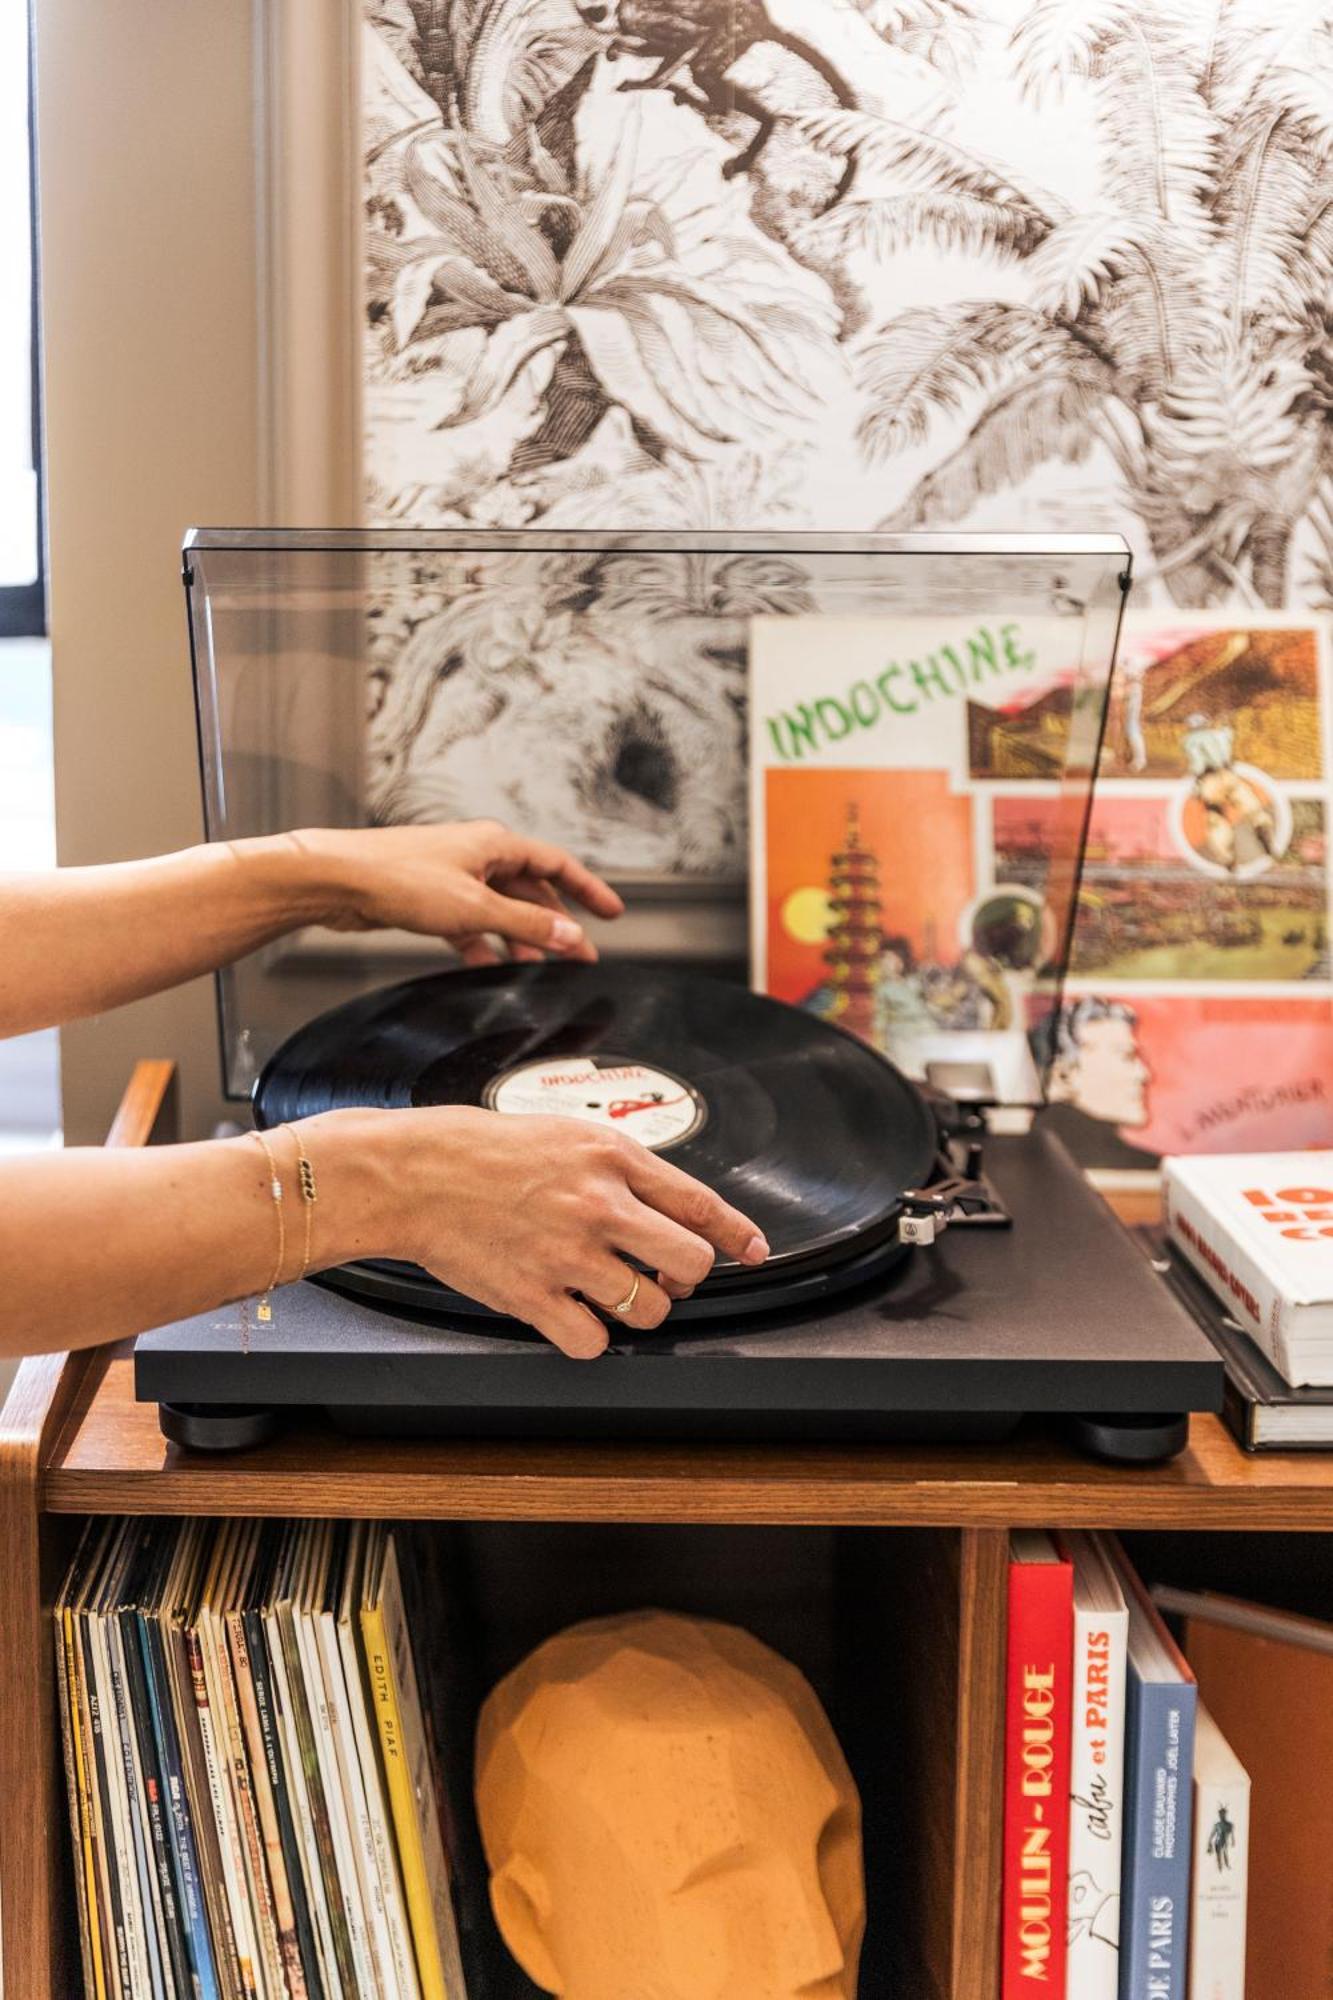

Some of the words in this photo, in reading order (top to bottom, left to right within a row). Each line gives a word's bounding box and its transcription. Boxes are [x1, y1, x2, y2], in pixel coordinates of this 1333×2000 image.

[766, 624, 1034, 760] INDOCHINE
[373, 1655, 389, 1702] EDITH
[384, 1720, 398, 1757] PIAF
[1086, 1631, 1110, 1729] PARIS
[1022, 1663, 1055, 1797] ROUGE
[1091, 1739, 1106, 1765] et
[1153, 1817, 1165, 1858] CLAUDE
[1148, 1896, 1174, 1969] PARIS
